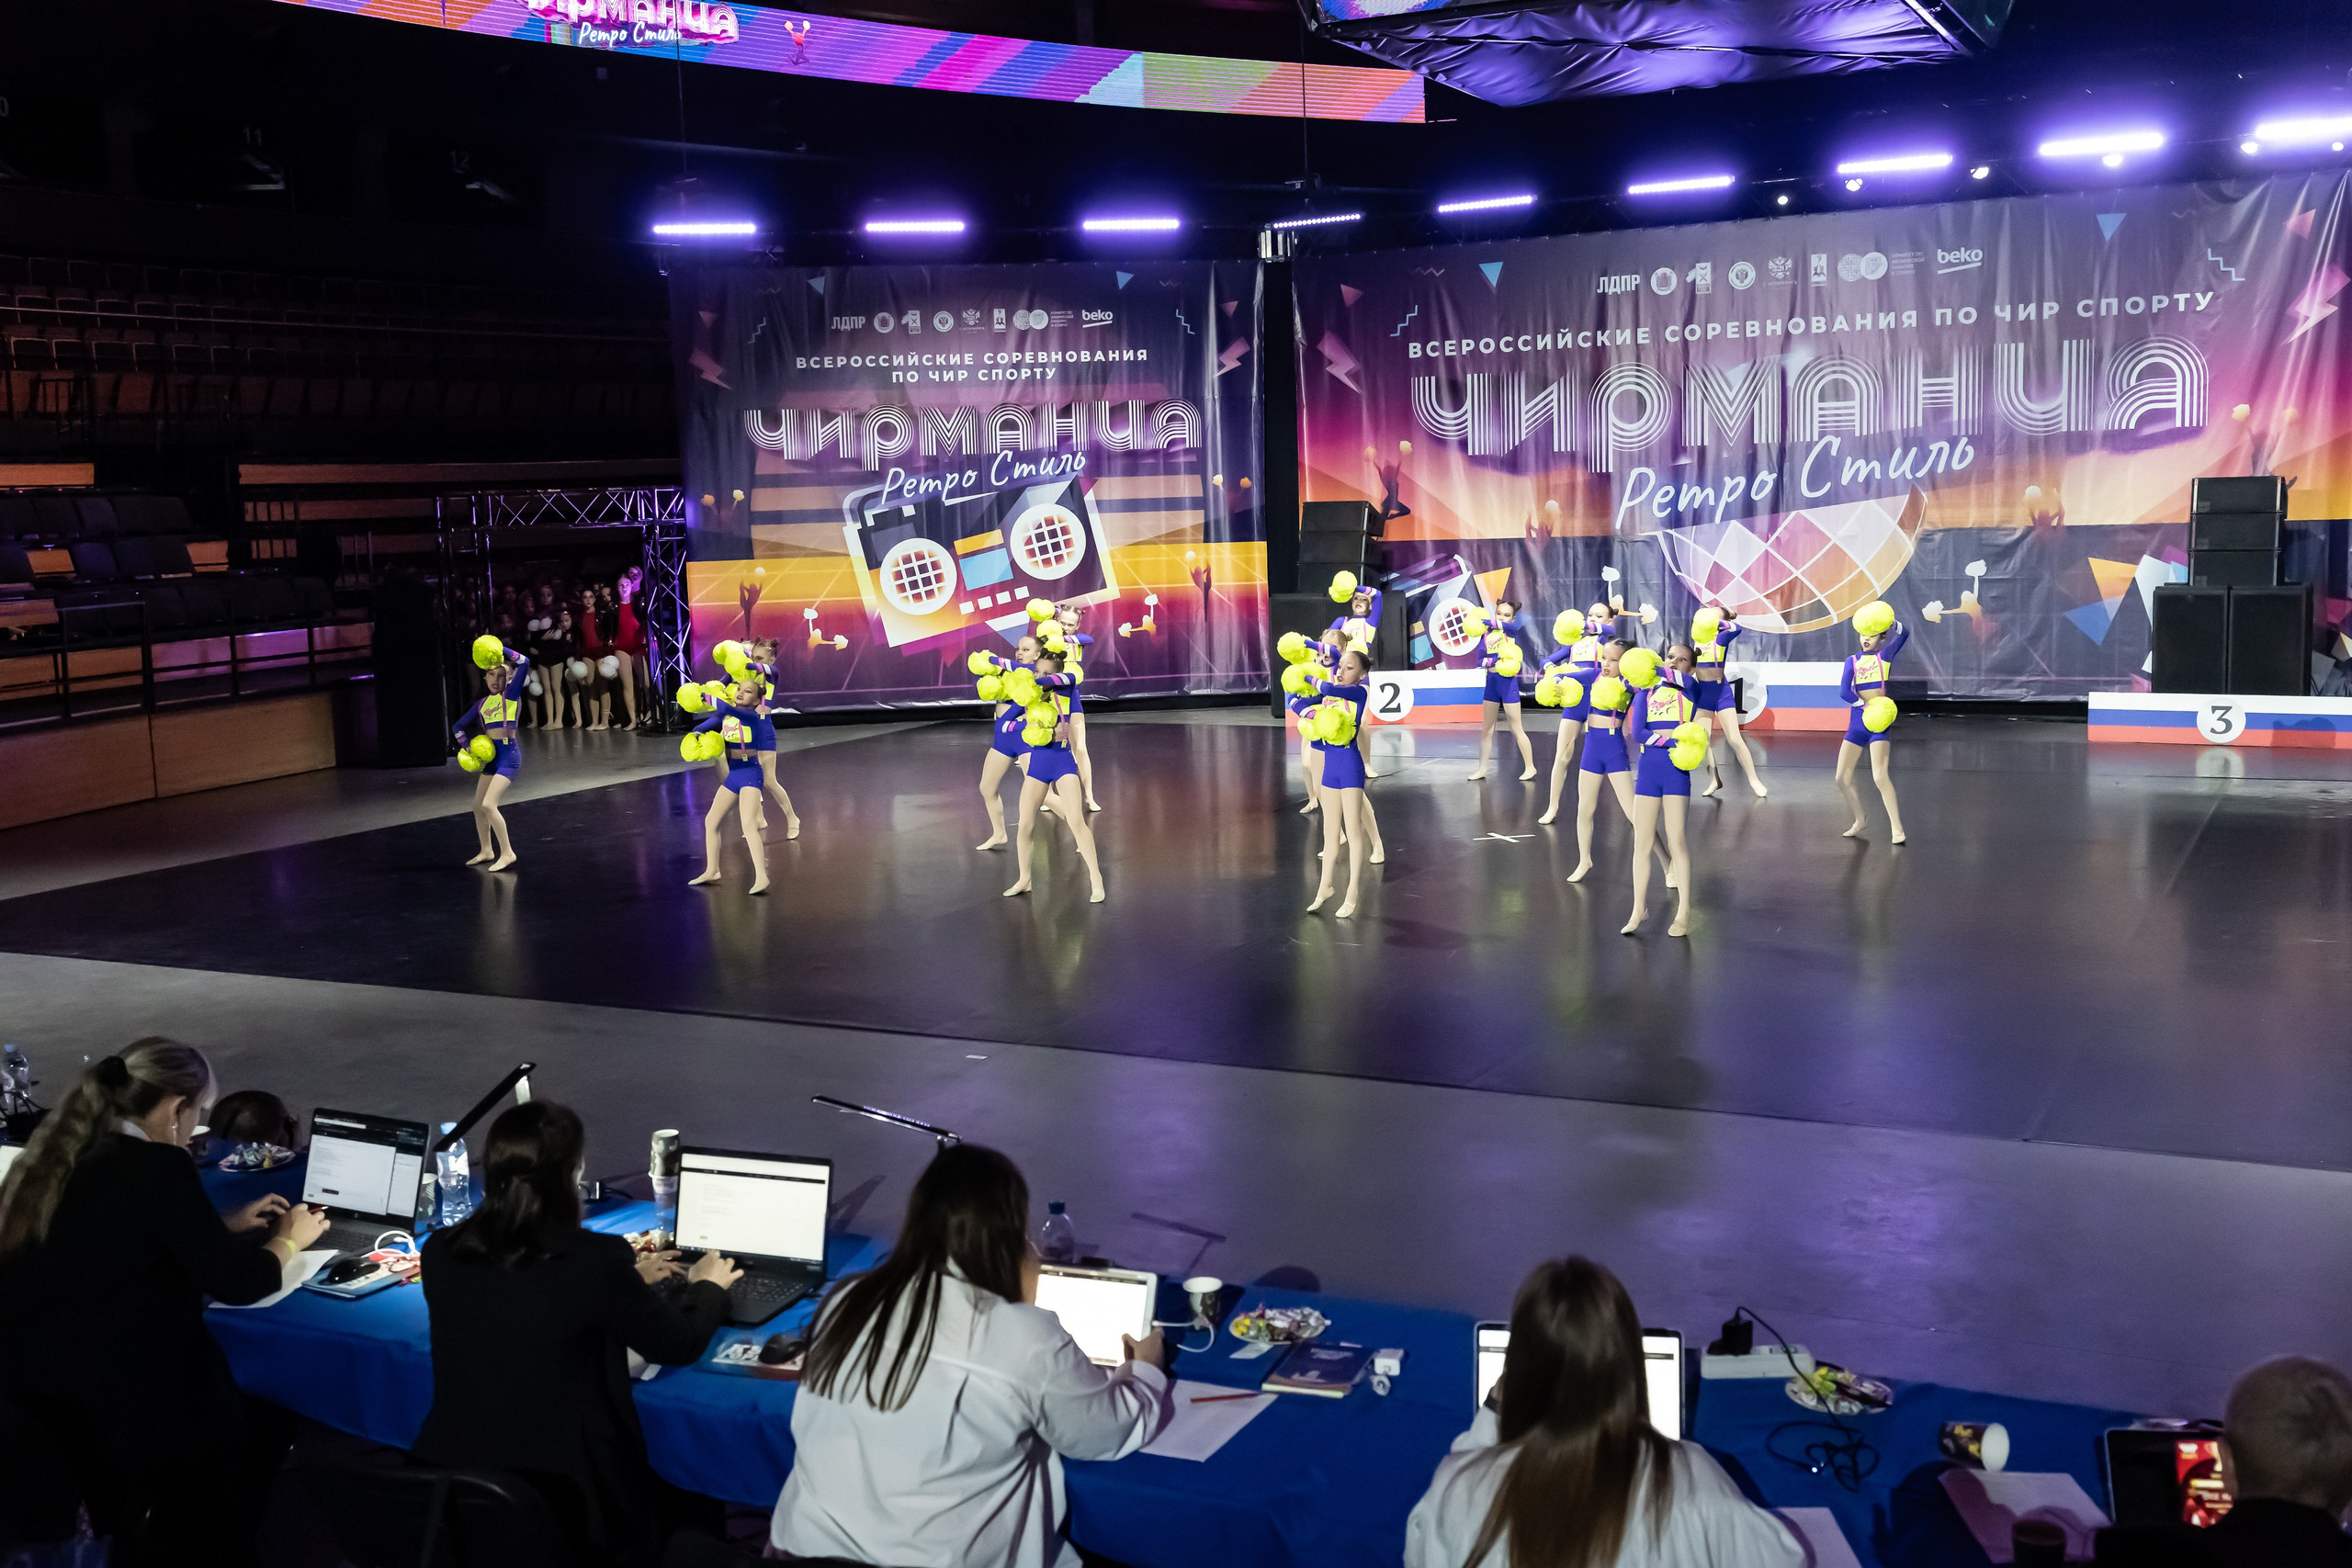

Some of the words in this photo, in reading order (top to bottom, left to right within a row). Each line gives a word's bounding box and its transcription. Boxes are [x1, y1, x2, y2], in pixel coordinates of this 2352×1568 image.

[578, 22, 628, 48] Ретро
[242, 125, 263, 147] 11
[1937, 247, 1984, 264] beko
[1597, 275, 1640, 295] ЛДПР
[831, 316, 865, 331] ЛДПР
[1082, 310, 1114, 321] beko
[1408, 327, 1650, 358] ВСЕРОССИЙСКИЕ
[1664, 310, 1918, 344] СОРЕВНОВАНИЯ
[1935, 306, 1978, 326] ПО
[1995, 301, 2060, 322] ЧИР
[2076, 291, 2214, 318] СПОРТУ
[796, 351, 974, 368] ВСЕРОССИЙСКИЕ
[983, 348, 1148, 366] СОРЕВНОВАНИЯ
[891, 370, 919, 383] ПО
[928, 369, 968, 382] ЧИР
[978, 367, 1057, 381] СПОРТУ
[880, 467, 978, 506] Ретро
[991, 449, 1087, 487] Стиль
[1615, 467, 1779, 530] Ретро
[1800, 434, 1974, 499] Стиль
[1379, 682, 1402, 714] 2
[1728, 677, 1748, 714] 1
[2210, 705, 2233, 734] 3
